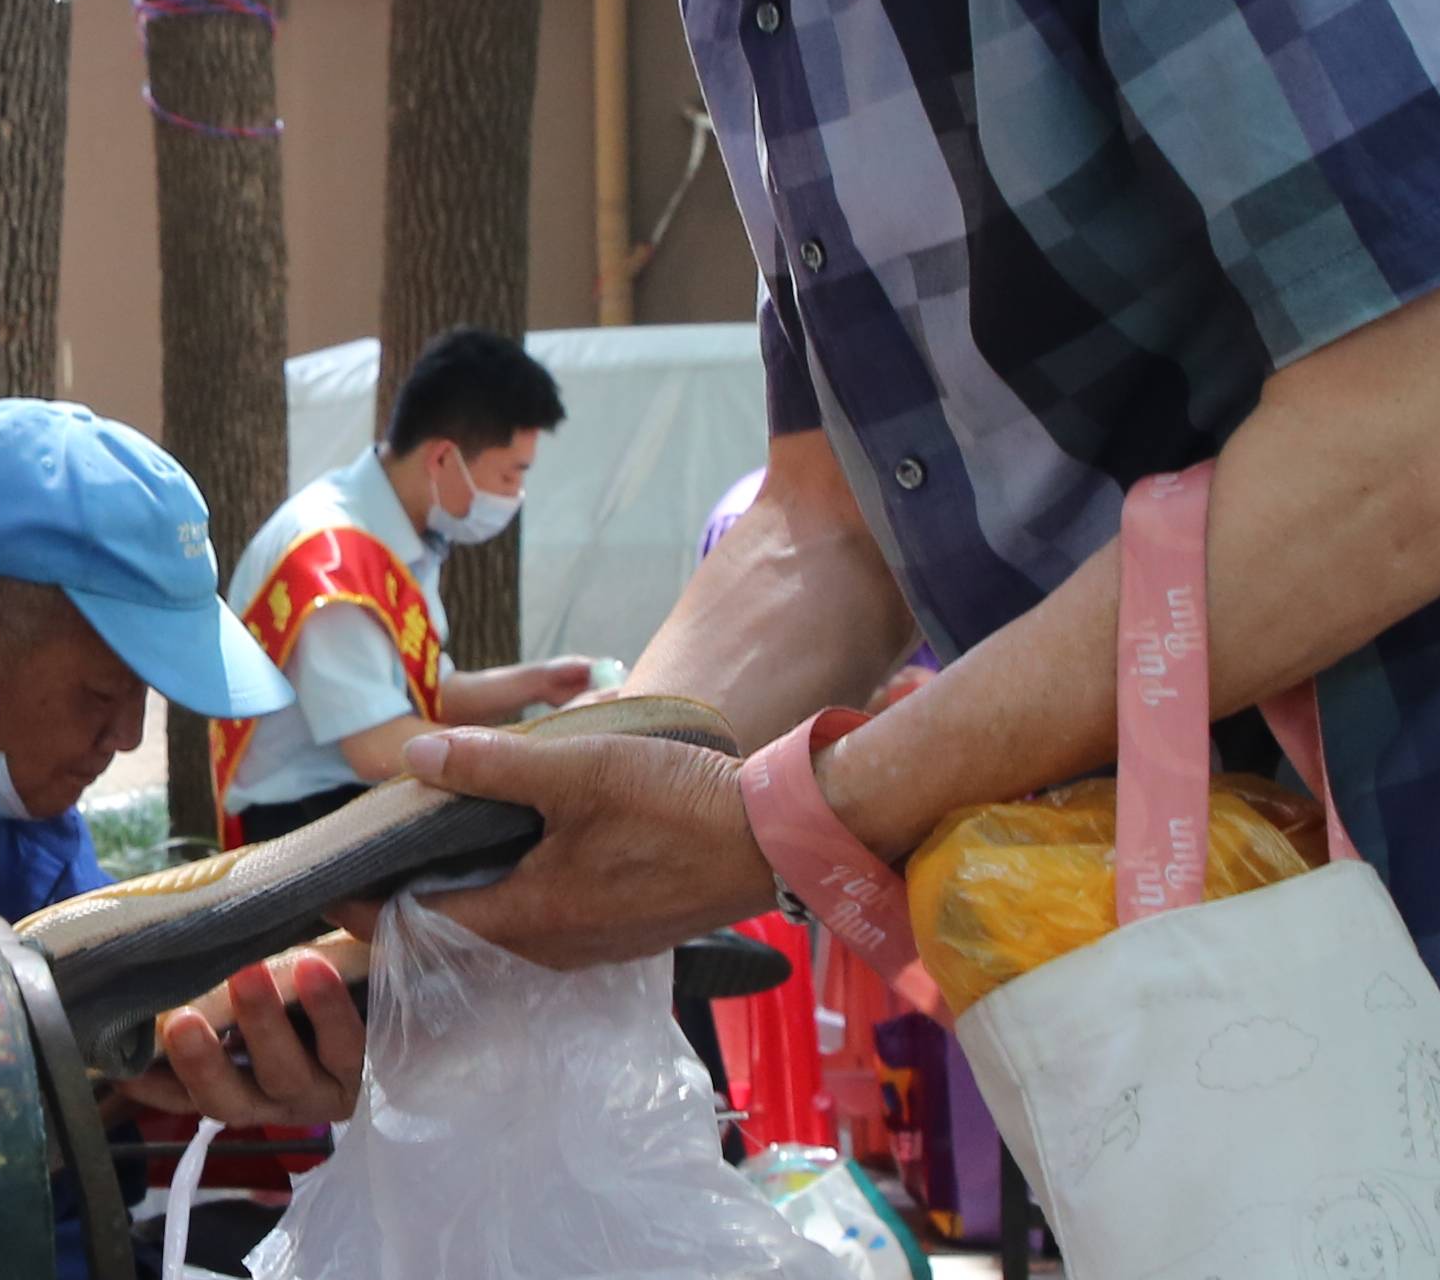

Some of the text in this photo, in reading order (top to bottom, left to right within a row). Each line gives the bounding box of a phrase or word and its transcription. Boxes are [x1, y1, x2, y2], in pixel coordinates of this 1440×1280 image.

[1163, 583, 1204, 660] Run
[1123, 844, 1167, 920] ink
[1163, 814, 1204, 890] Run
